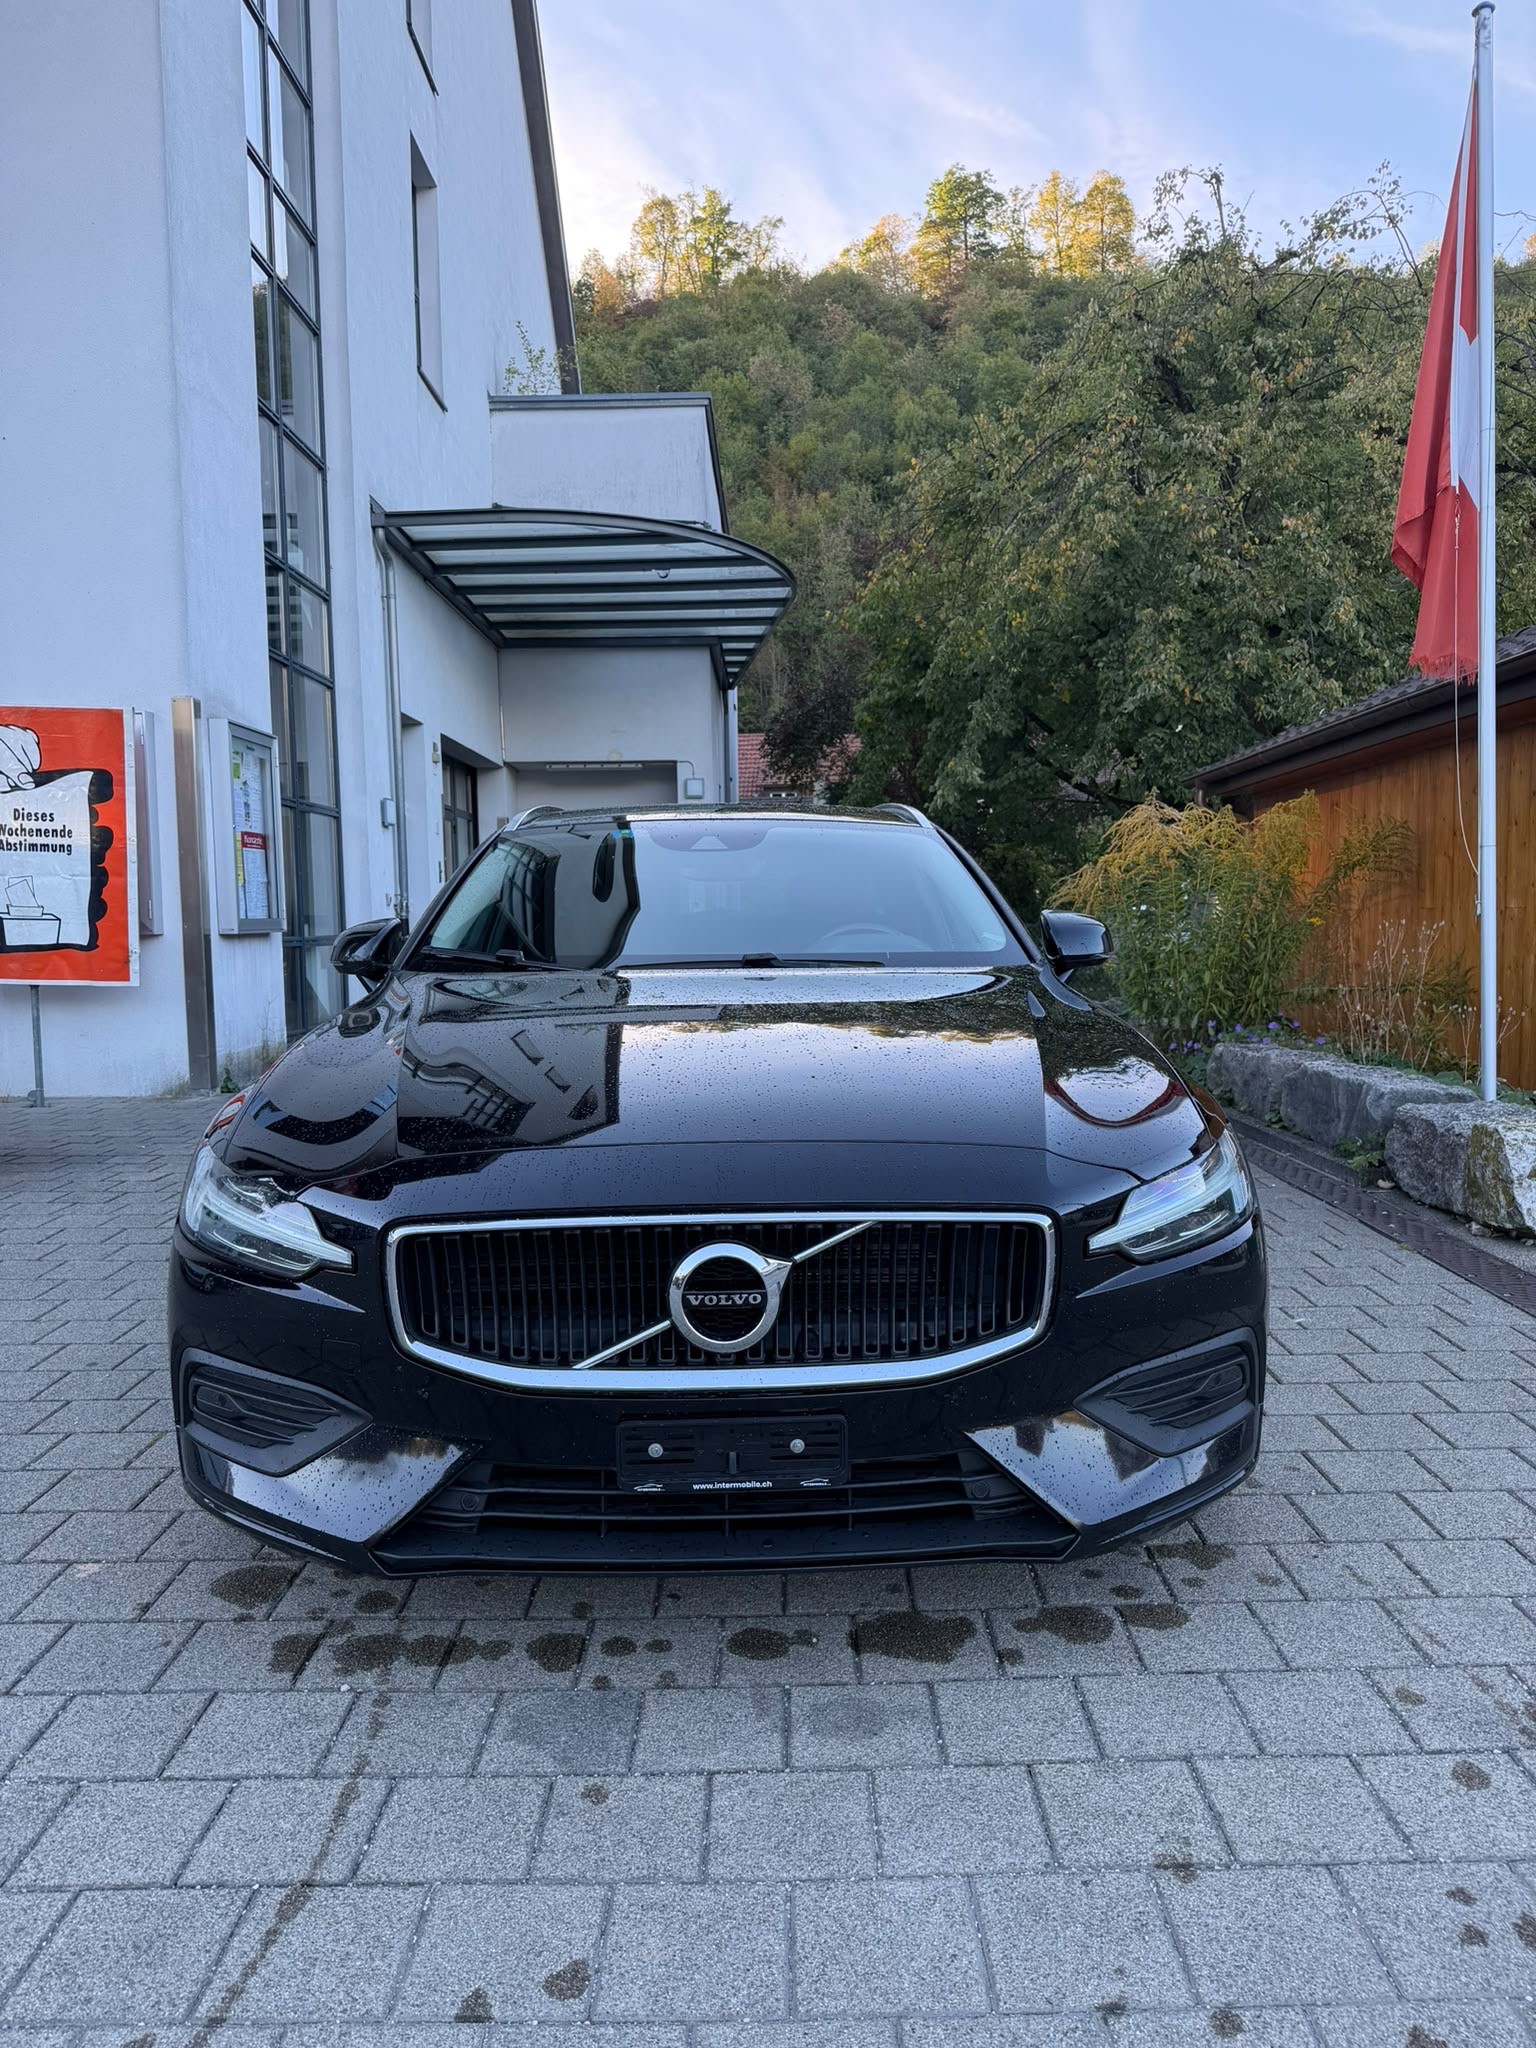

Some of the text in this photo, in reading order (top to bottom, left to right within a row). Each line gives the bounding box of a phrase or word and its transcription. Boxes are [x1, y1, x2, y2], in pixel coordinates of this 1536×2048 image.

[13, 807, 55, 822] Dieses
[686, 1294, 762, 1306] VOLVO
[692, 1480, 773, 1490] www.intermobile.ch
